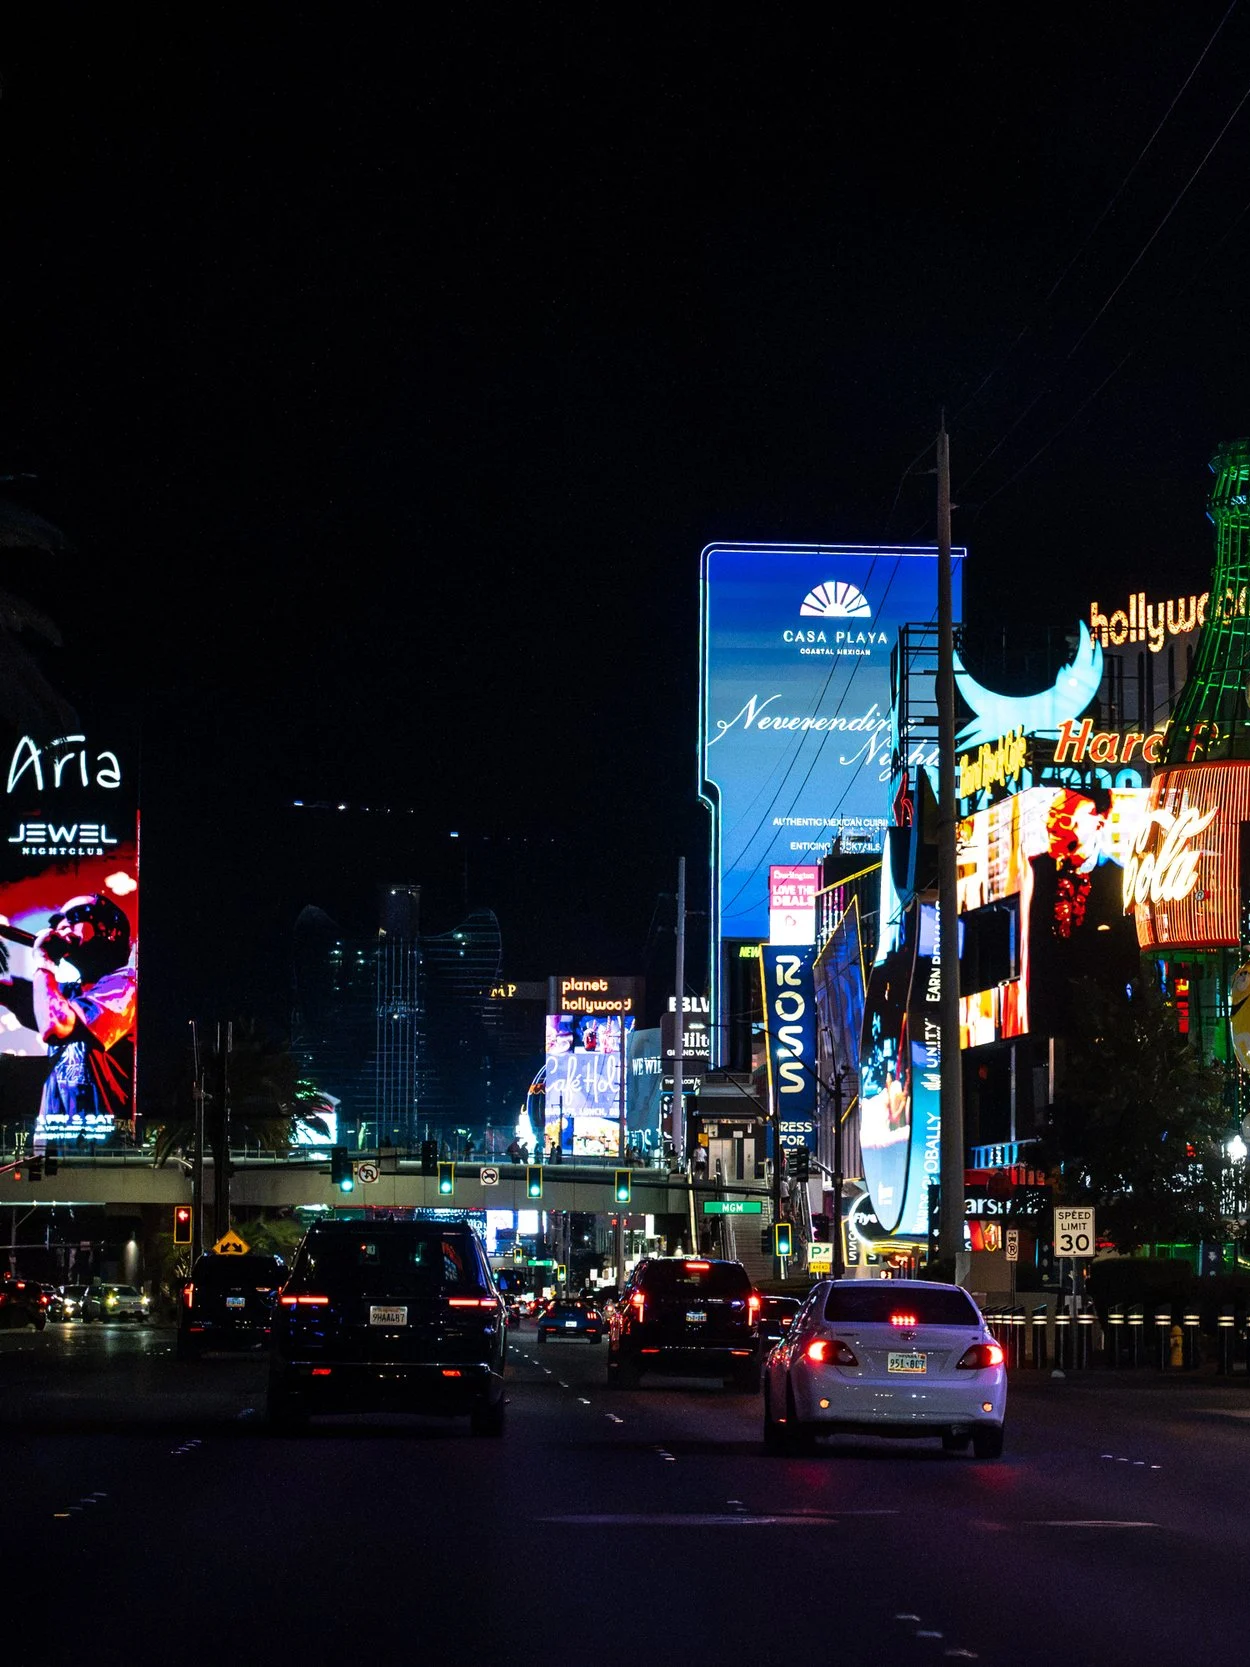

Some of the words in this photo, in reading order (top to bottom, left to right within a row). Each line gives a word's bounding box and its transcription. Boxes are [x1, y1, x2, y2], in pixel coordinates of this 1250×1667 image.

[783, 630, 827, 644] CASA
[835, 630, 888, 644] PLAYA
[706, 694, 916, 746] Neverendin
[7, 735, 121, 794] Aria
[773, 817, 823, 826] AUTHENTIC
[823, 818, 863, 827] MEXICAN
[8, 823, 118, 844] JEWEL
[22, 847, 104, 856] NIGHTCLUB
[773, 870, 815, 881] Burlington
[772, 885, 796, 895] LOVE
[797, 885, 816, 895] THE
[772, 895, 816, 907] DEALS
[562, 978, 608, 994] planet
[926, 968, 941, 1001] EARN
[562, 998, 632, 1013] hollywood
[775, 955, 805, 1093] ROSS
[925, 1022, 938, 1068] UNITY
[779, 1121, 813, 1132] RESS
[722, 1203, 743, 1213] MGM
[1058, 1211, 1091, 1220] SPEED
[1061, 1222, 1088, 1231] LIMIT
[1060, 1234, 1090, 1251] 30
